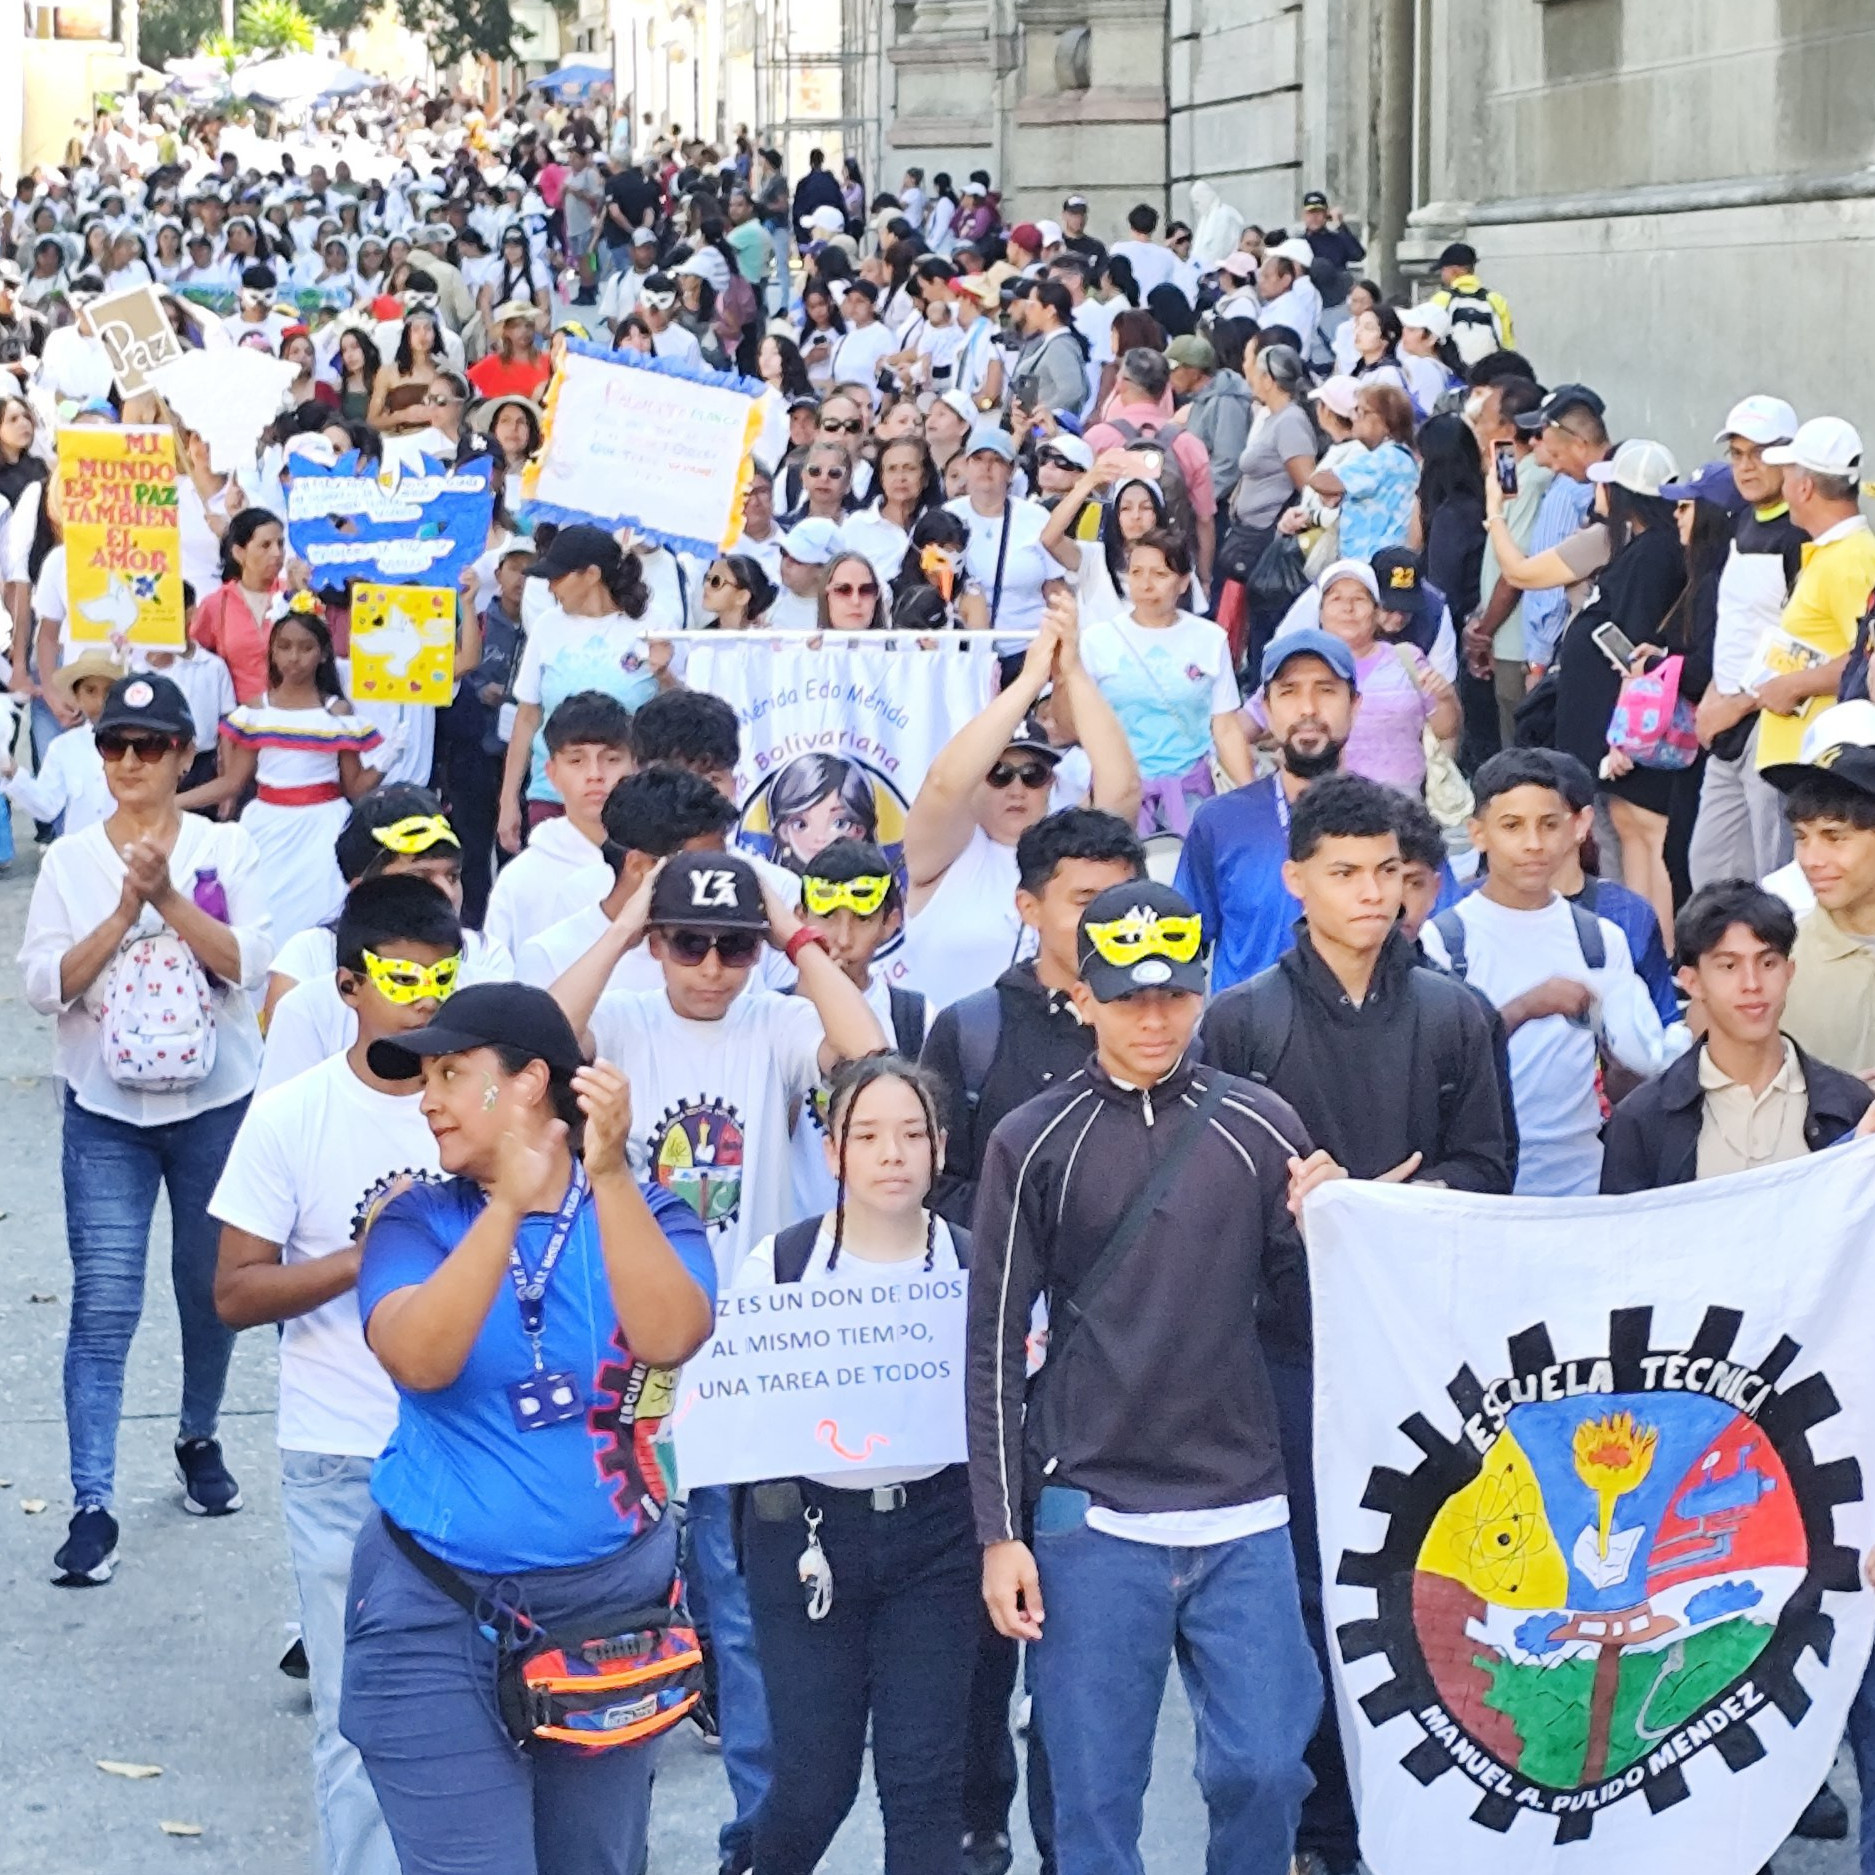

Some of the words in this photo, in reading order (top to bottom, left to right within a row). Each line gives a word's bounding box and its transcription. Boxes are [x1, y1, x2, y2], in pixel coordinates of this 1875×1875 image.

[100, 320, 181, 377] Paz
[125, 432, 159, 455] MI
[78, 458, 175, 482] MUNDO
[99, 482, 132, 503] MI
[135, 483, 179, 506] PAZ
[88, 546, 170, 574] AMOR
[806, 678, 841, 702] Edo
[754, 725, 900, 773] Bolivariana
[737, 1295, 762, 1315] ES
[769, 1291, 803, 1312] UN
[811, 1287, 863, 1308] DON
[872, 1285, 900, 1304] DE
[908, 1280, 963, 1300] DIOS
[711, 1339, 738, 1358] AL
[745, 1328, 830, 1354] MISMO
[837, 1322, 934, 1347] TIEMPO,
[699, 1377, 750, 1399] UNA
[757, 1369, 829, 1393] TAREA
[838, 1366, 865, 1386] DE
[873, 1360, 951, 1382] TODOS
[1464, 1360, 1614, 1455] ESCUELA
[1420, 1704, 1513, 1797] MANUEL
[1515, 1786, 1545, 1809] A.
[1551, 1765, 1645, 1813] PULIDO
[1648, 1681, 1765, 1776] MENDEZ
